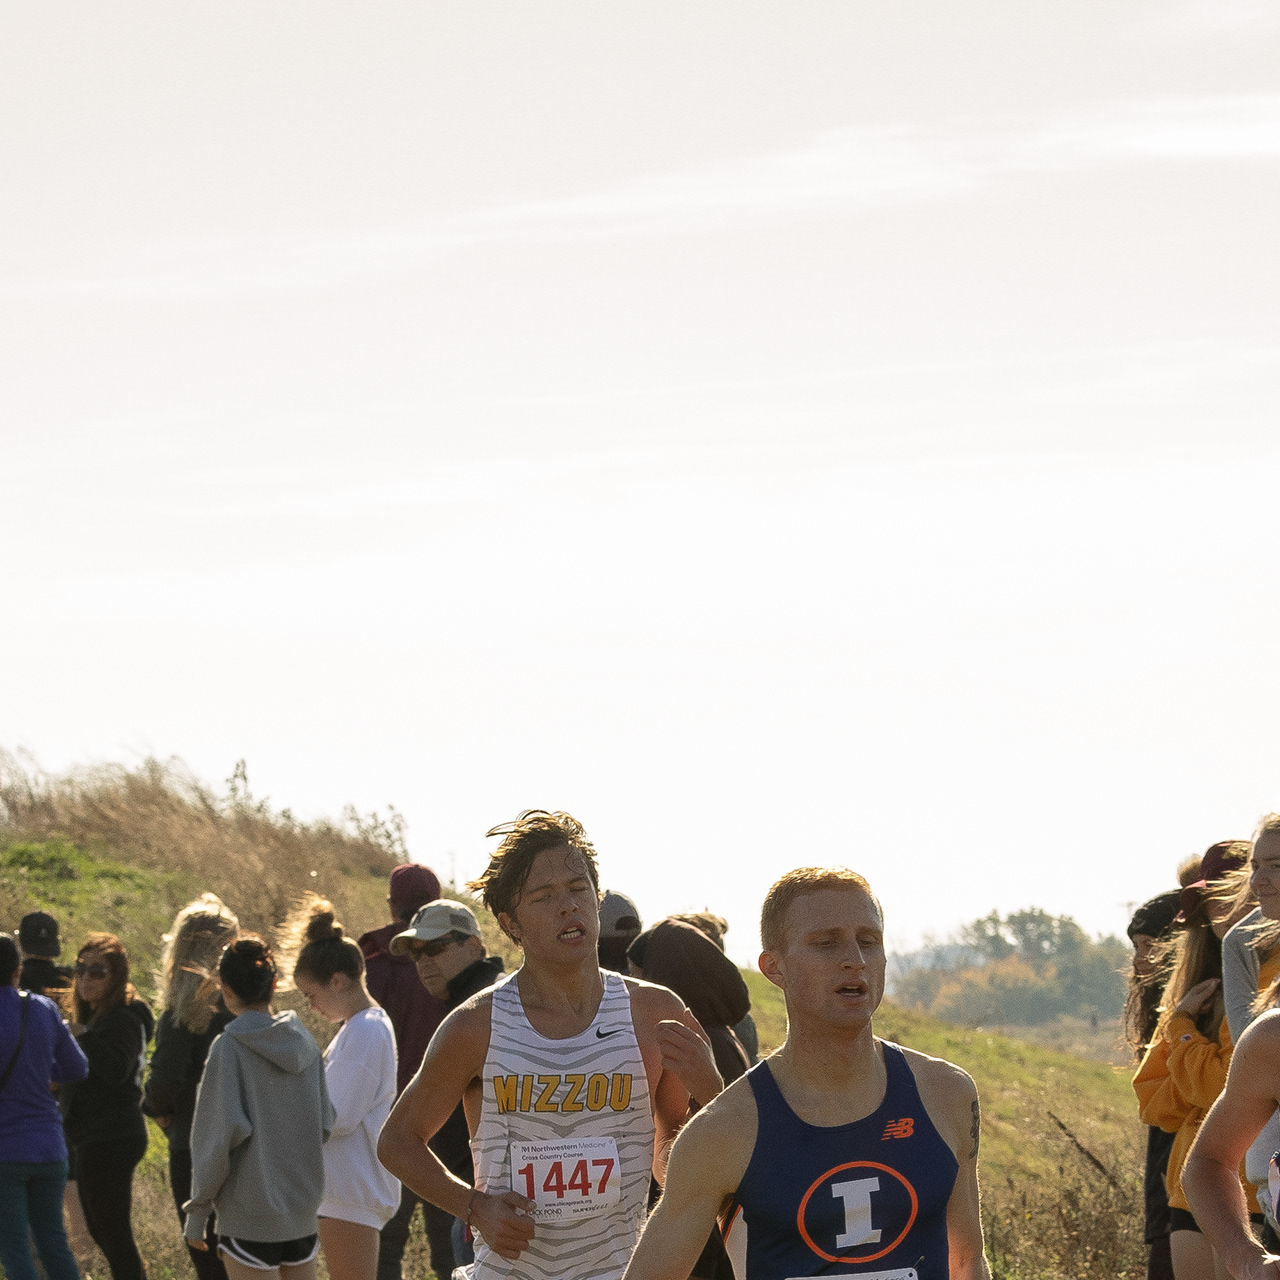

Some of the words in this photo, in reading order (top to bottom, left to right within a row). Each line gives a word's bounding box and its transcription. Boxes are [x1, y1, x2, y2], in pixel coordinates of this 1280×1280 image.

[493, 1073, 633, 1114] MIZZOU
[531, 1144, 578, 1153] Northwestern
[578, 1142, 606, 1150] Medicine
[539, 1153, 562, 1161] Country
[563, 1151, 584, 1159] Course
[518, 1158, 615, 1200] 1447
[544, 1199, 593, 1208] www.chicagotrack.org
[543, 1208, 562, 1216] POND
[831, 1177, 882, 1249] I
